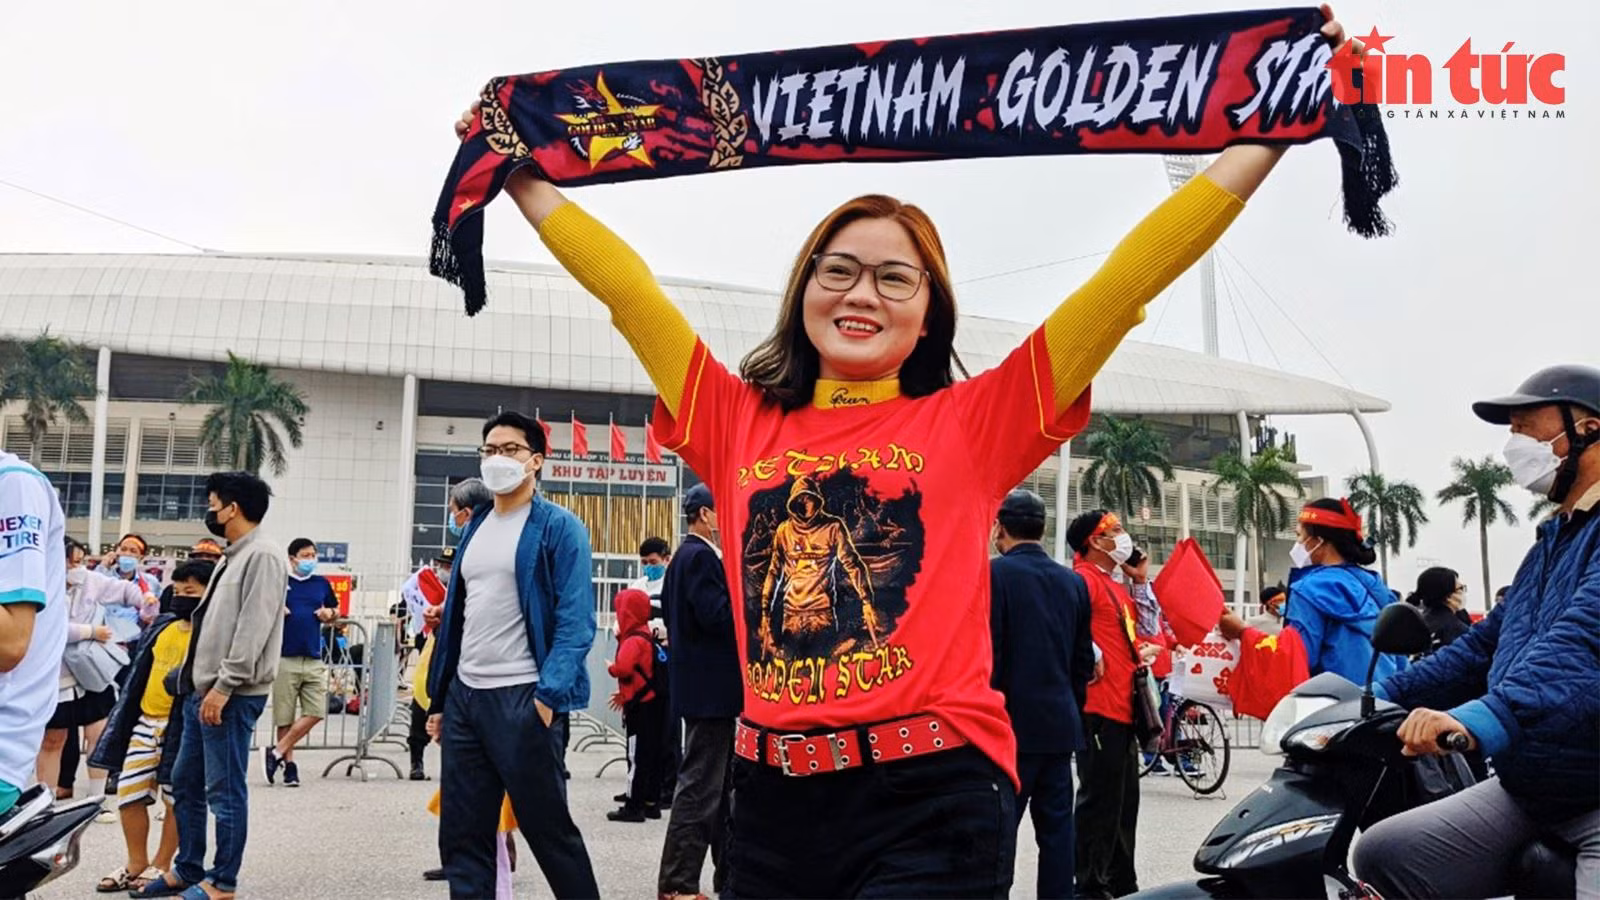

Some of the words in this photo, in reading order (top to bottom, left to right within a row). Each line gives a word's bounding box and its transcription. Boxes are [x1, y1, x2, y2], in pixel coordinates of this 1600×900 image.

[752, 55, 966, 144] VIETNAM
[996, 40, 1217, 136] GOLDEN
[567, 122, 618, 135] GOLDEN
[623, 117, 656, 131] STAR
[552, 465, 582, 478] KHU
[3, 531, 39, 548] TIRE
[835, 645, 913, 699] STAR
